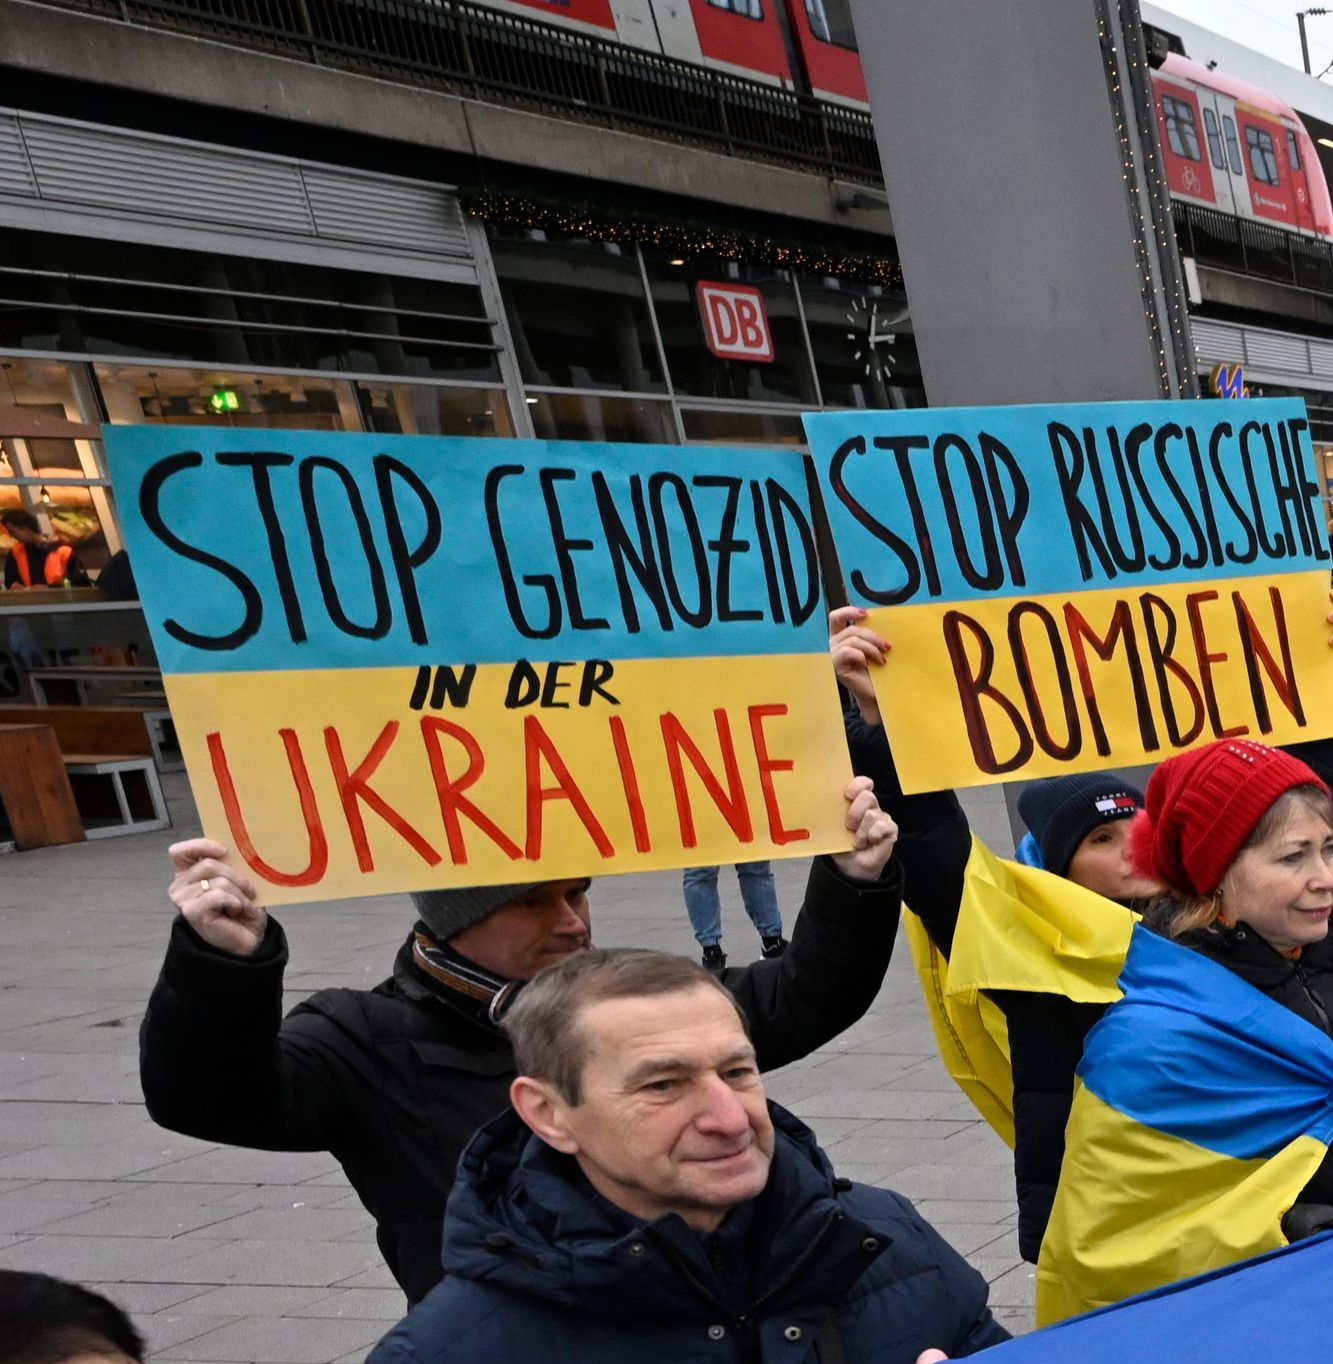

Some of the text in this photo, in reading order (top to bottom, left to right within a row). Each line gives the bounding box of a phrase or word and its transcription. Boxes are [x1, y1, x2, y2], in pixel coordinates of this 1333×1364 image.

[708, 293, 765, 350] DB
[139, 451, 822, 652] STOP GENOZID
[829, 417, 1329, 606] STOP RUSSISCHE
[409, 658, 622, 710] IN DER
[942, 586, 1308, 776] BOMBEN
[206, 703, 812, 888] UKRAINE
